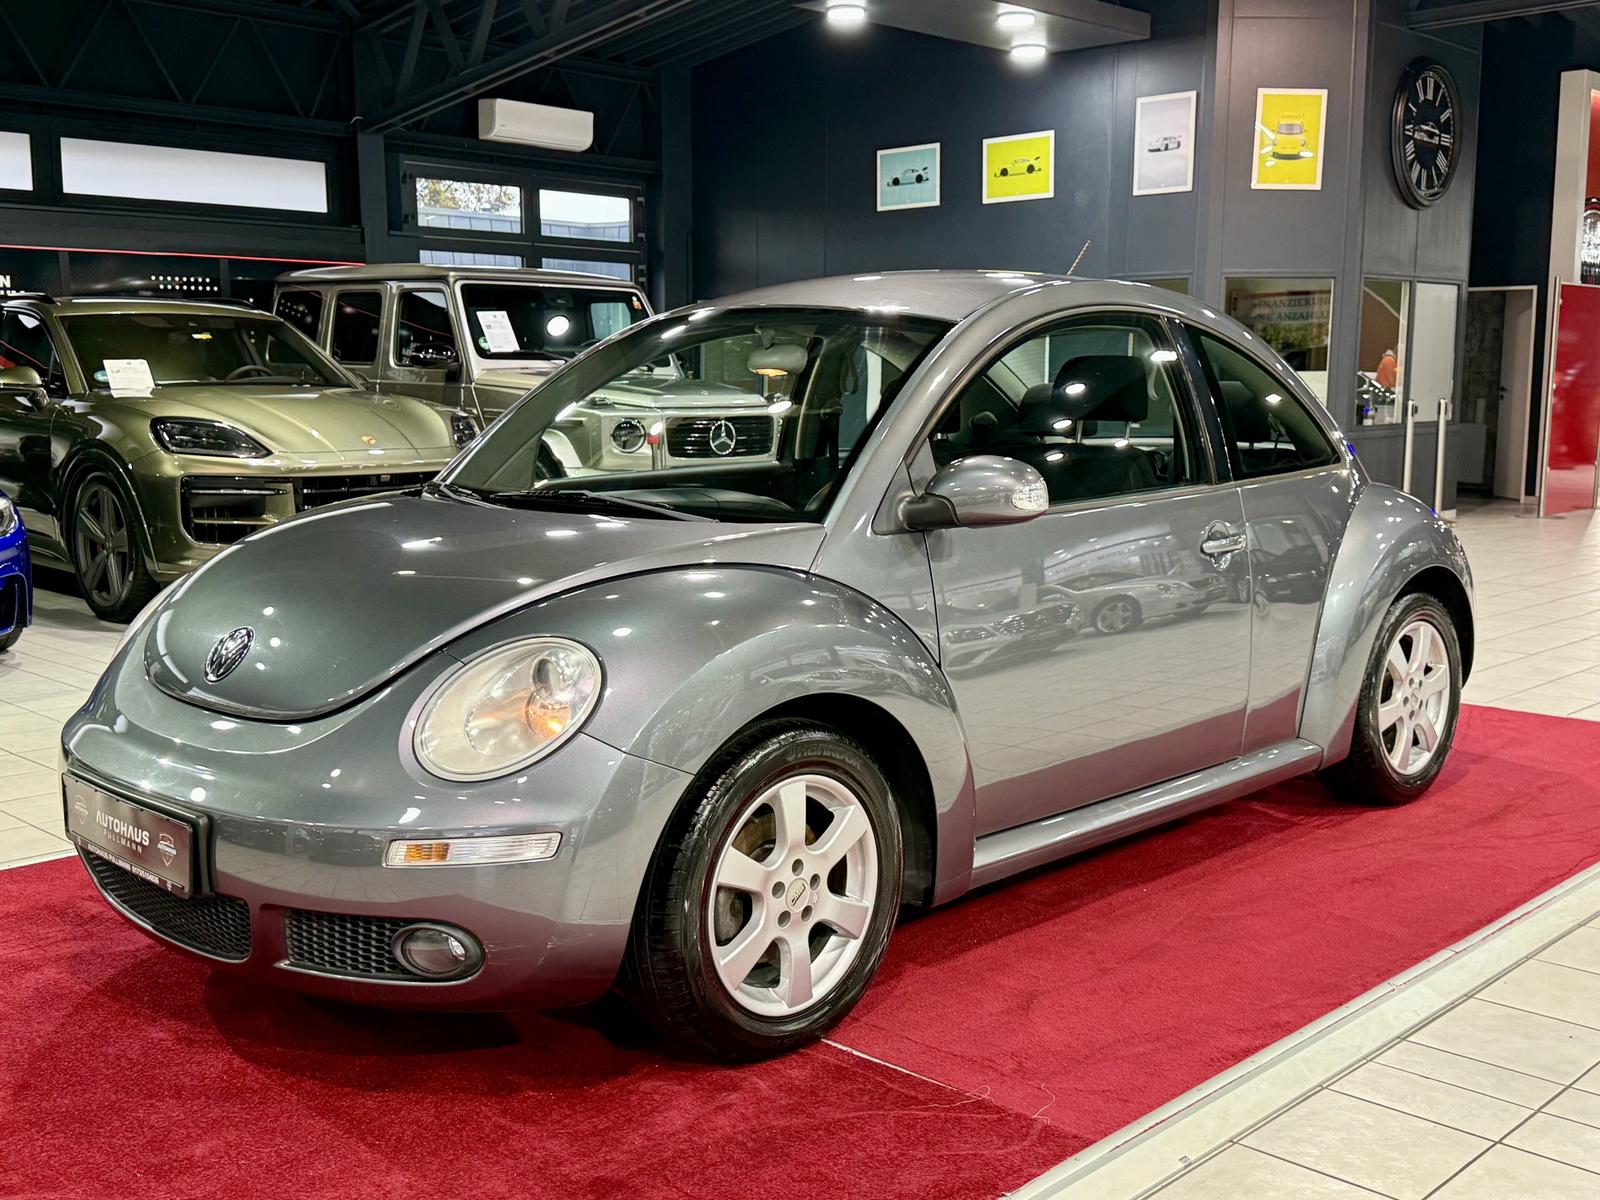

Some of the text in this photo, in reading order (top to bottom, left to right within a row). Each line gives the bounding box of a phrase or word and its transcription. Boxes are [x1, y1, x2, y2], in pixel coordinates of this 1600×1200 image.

[1252, 296, 1330, 309] FINANZIERUN
[96, 810, 150, 846] AUTOHAUS
[103, 829, 143, 854] PULLMANN
